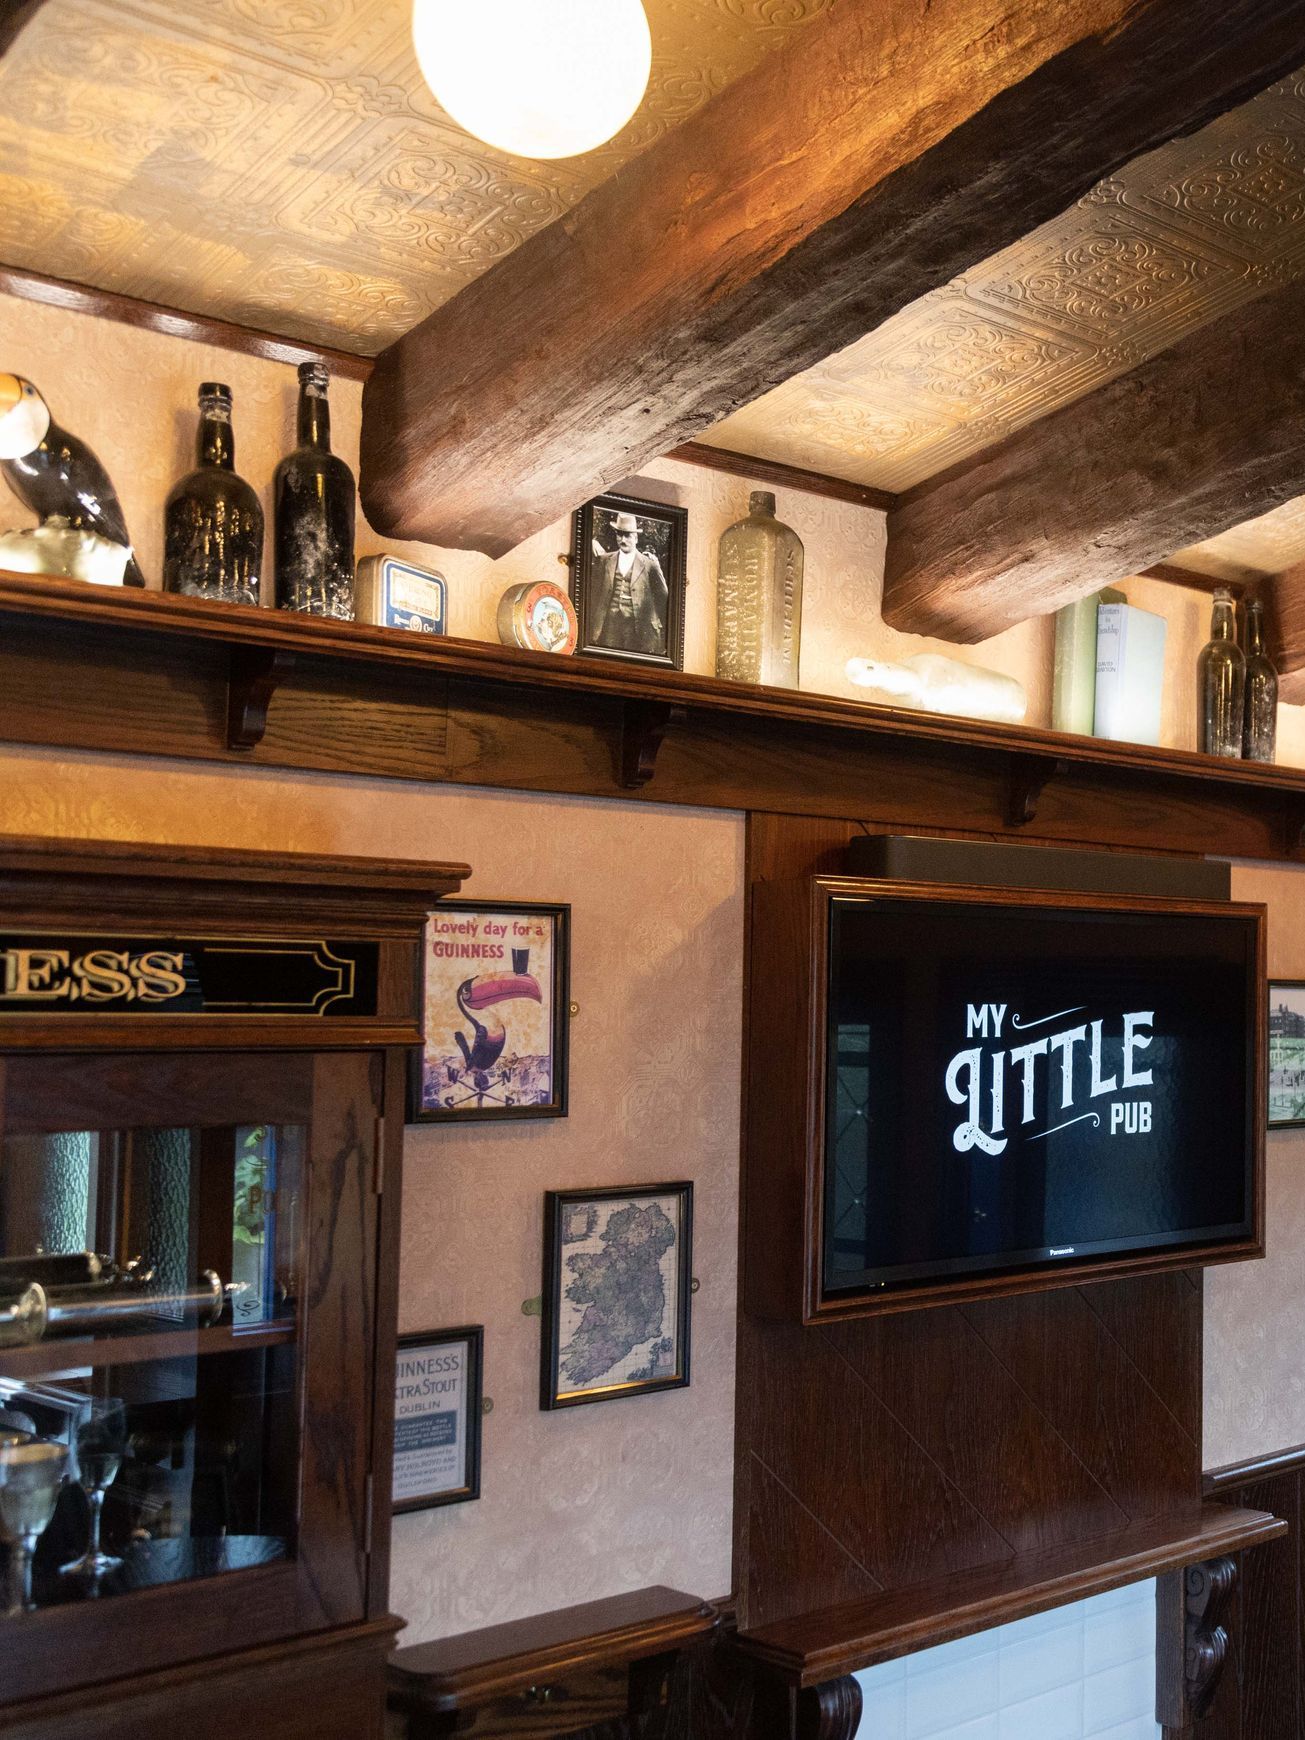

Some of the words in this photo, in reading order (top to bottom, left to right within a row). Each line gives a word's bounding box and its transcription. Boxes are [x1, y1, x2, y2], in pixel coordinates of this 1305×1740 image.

[433, 918, 479, 937] Lovely
[483, 921, 508, 938] day
[512, 921, 530, 935] for
[535, 925, 544, 936] a
[432, 941, 505, 959] GUINNESS
[966, 1003, 1008, 1038] MY
[945, 1010, 1155, 1156] LITTLE
[1110, 1101, 1153, 1135] PUB
[1049, 1246, 1075, 1256] Panasonic
[399, 1400, 441, 1414] DUBLIN
